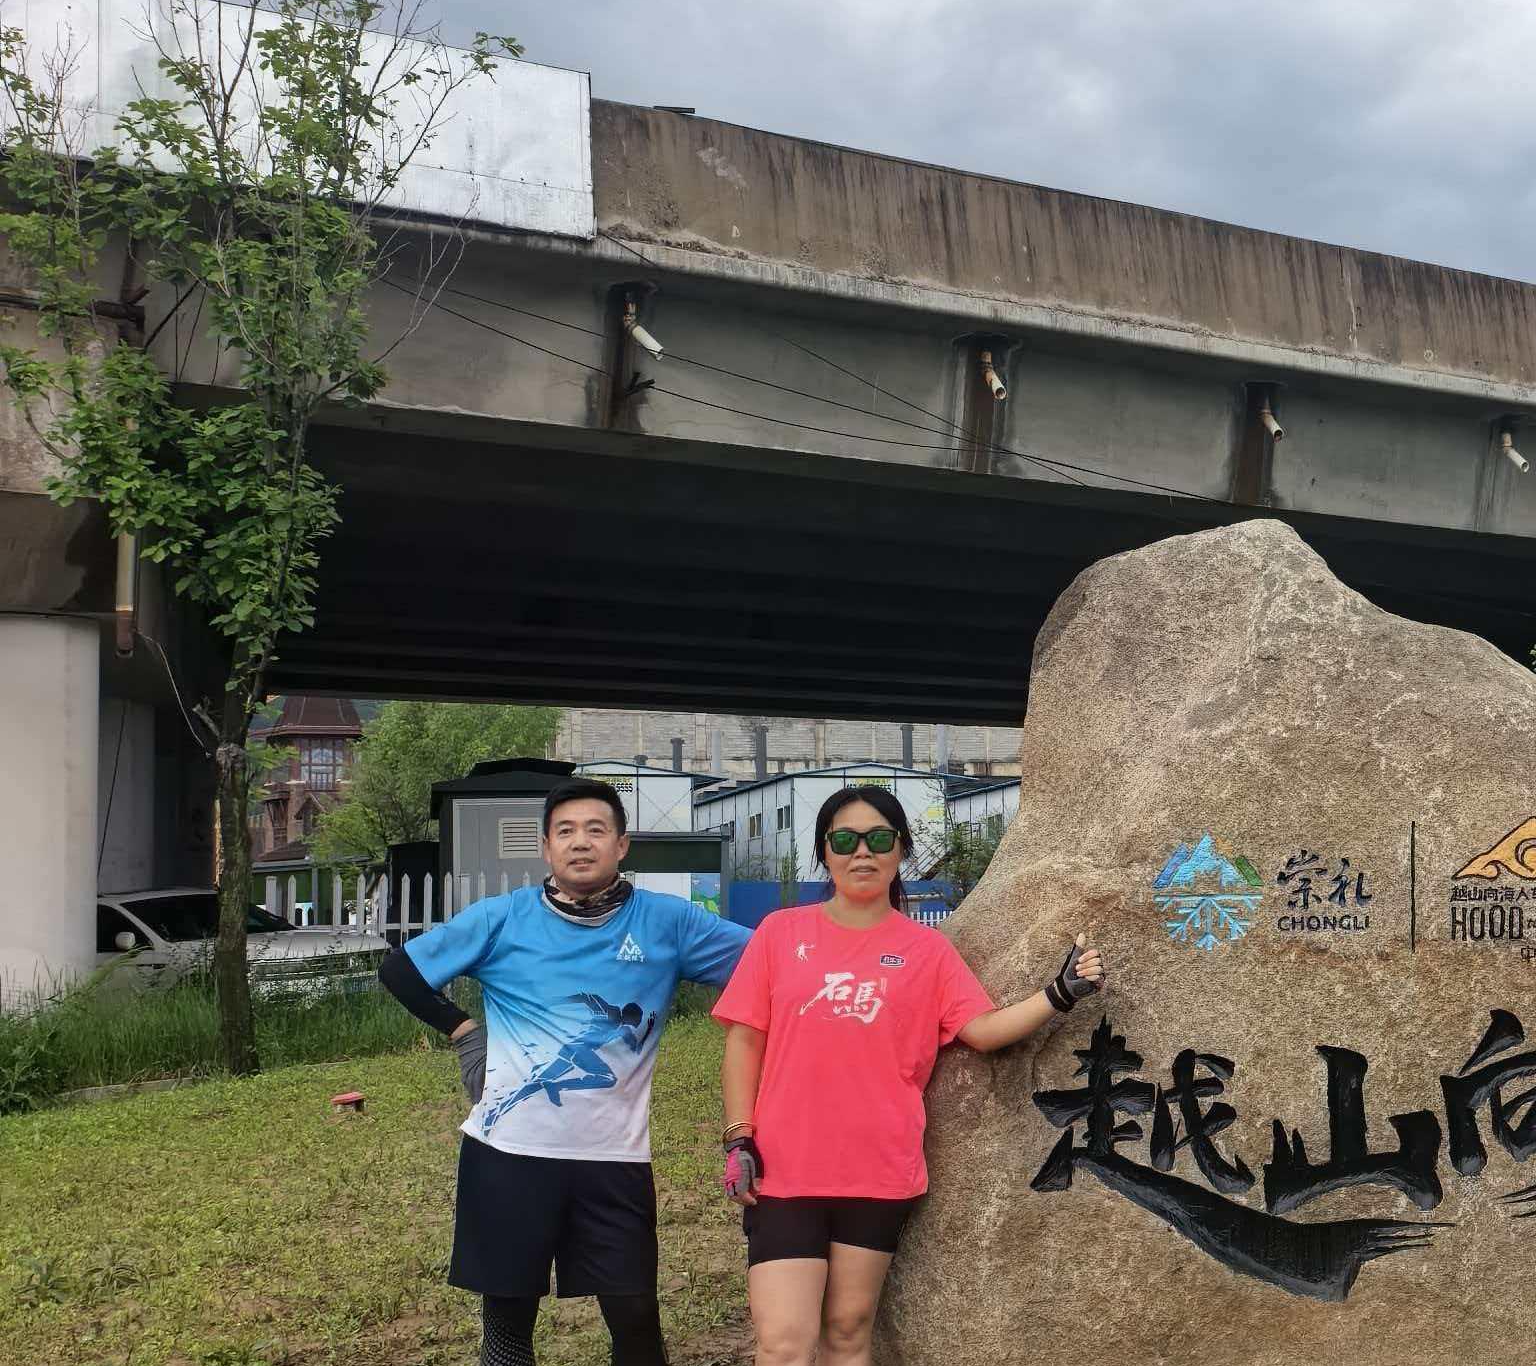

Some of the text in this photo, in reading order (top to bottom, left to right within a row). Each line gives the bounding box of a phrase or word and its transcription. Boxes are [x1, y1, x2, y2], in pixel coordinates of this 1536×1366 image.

[1277, 849, 1373, 909] 崇礼
[1278, 915, 1370, 931] CHONGLI
[1451, 905, 1524, 941] HOOD
